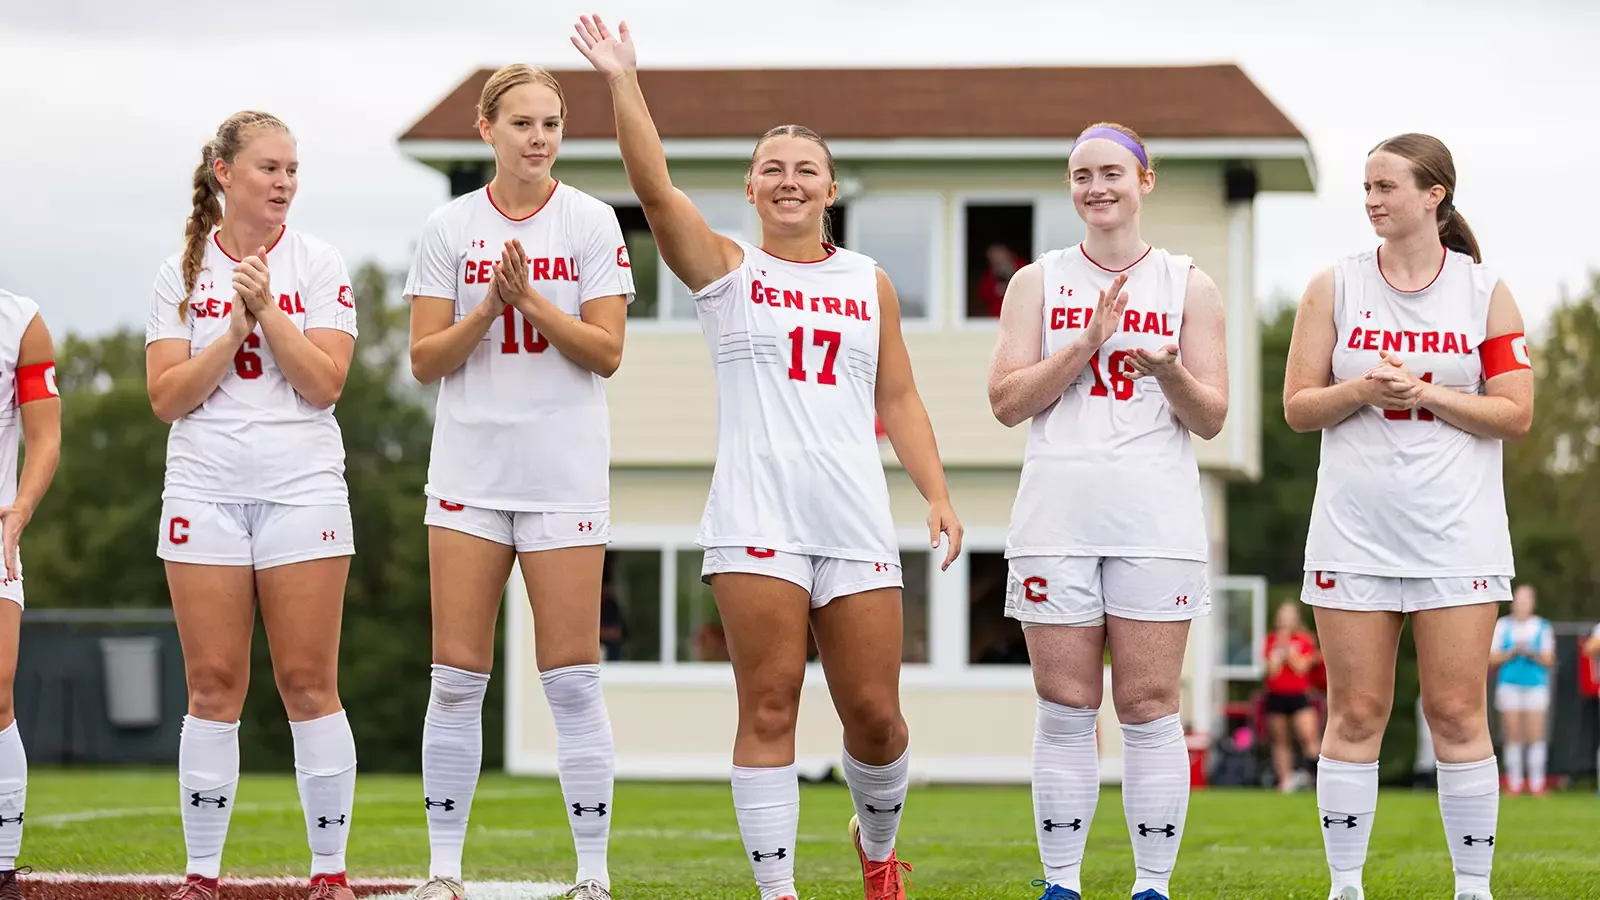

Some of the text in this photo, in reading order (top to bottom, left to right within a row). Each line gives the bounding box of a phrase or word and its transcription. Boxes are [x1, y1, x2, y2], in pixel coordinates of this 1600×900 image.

[464, 257, 579, 285] CERAL
[750, 279, 872, 322] CENTRAL
[1050, 307, 1174, 337] CERAL
[233, 331, 264, 380] 6
[788, 325, 842, 386] 17
[1347, 326, 1473, 355] CENTRAL
[1088, 349, 1139, 401] 18
[169, 516, 190, 545] C
[1023, 576, 1048, 603] C
